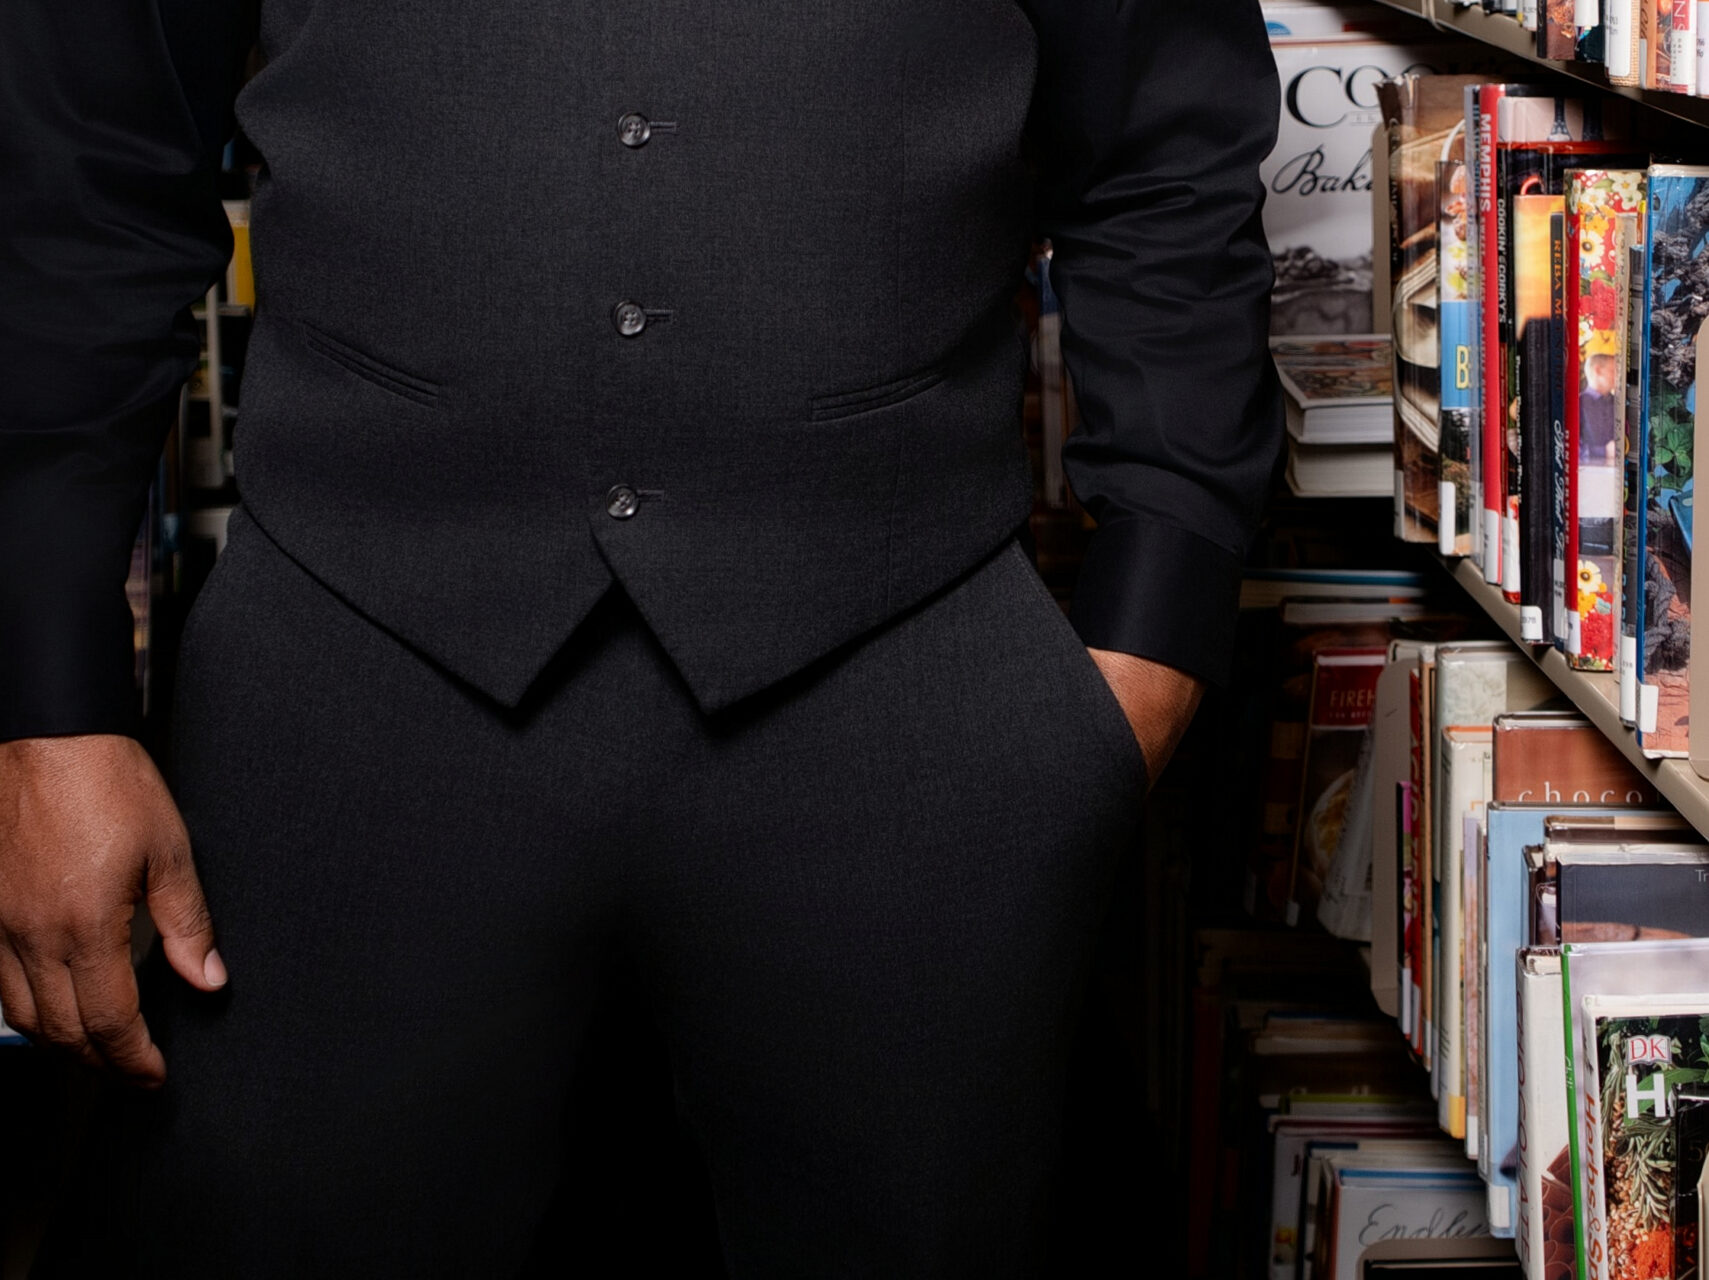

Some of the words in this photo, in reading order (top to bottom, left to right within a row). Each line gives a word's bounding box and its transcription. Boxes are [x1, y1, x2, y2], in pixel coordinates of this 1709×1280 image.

[1479, 113, 1493, 212] MEMPHIS
[1497, 198, 1507, 255] COOKIN'
[1553, 239, 1562, 290] REBA
[1498, 264, 1507, 323] CORKY'S
[1553, 420, 1565, 470] Not
[1554, 472, 1566, 524] That
[1518, 781, 1652, 803] choco
[1629, 1037, 1668, 1061] DK
[1517, 990, 1530, 1263] CHOCOLATE
